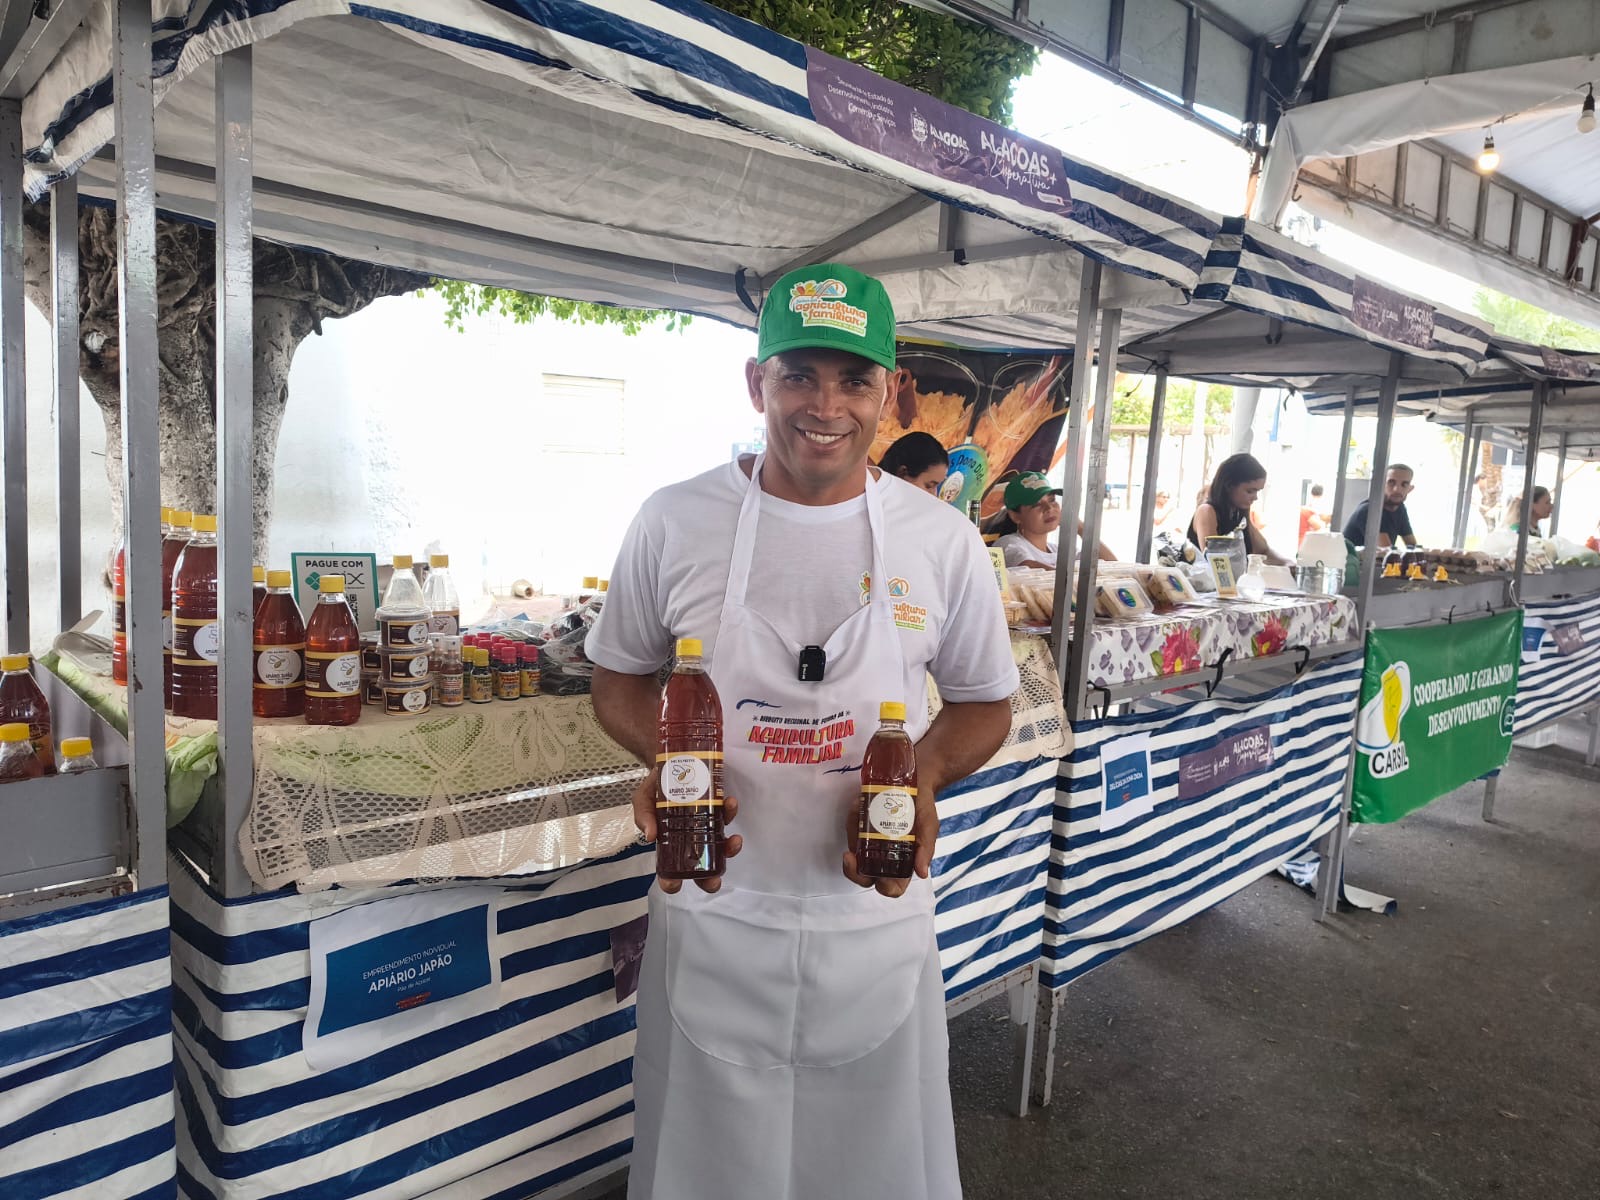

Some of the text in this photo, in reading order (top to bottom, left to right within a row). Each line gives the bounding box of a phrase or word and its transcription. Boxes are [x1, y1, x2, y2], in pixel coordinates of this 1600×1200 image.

[868, 92, 886, 102] Estado
[887, 98, 893, 106] do
[930, 124, 969, 151] ALAGOAS
[981, 131, 1050, 177] ALAGOAS
[795, 300, 866, 320] agricultura
[808, 309, 860, 326] familiar
[305, 560, 364, 568] PAGUE COM
[1413, 663, 1514, 707] COOPERANDO E GERANDO
[1428, 694, 1501, 737] DESENVOLVIMENTO
[748, 719, 855, 746] AGRICULTURA
[1233, 734, 1264, 754] ALAGOAS
[762, 742, 842, 764] FAMILIAR
[1372, 745, 1408, 774] CARSIL
[362, 940, 456, 980] EMPREENDIMENTO INDIVIDUAL
[368, 954, 452, 993] APIÁRIO JAPÃO
